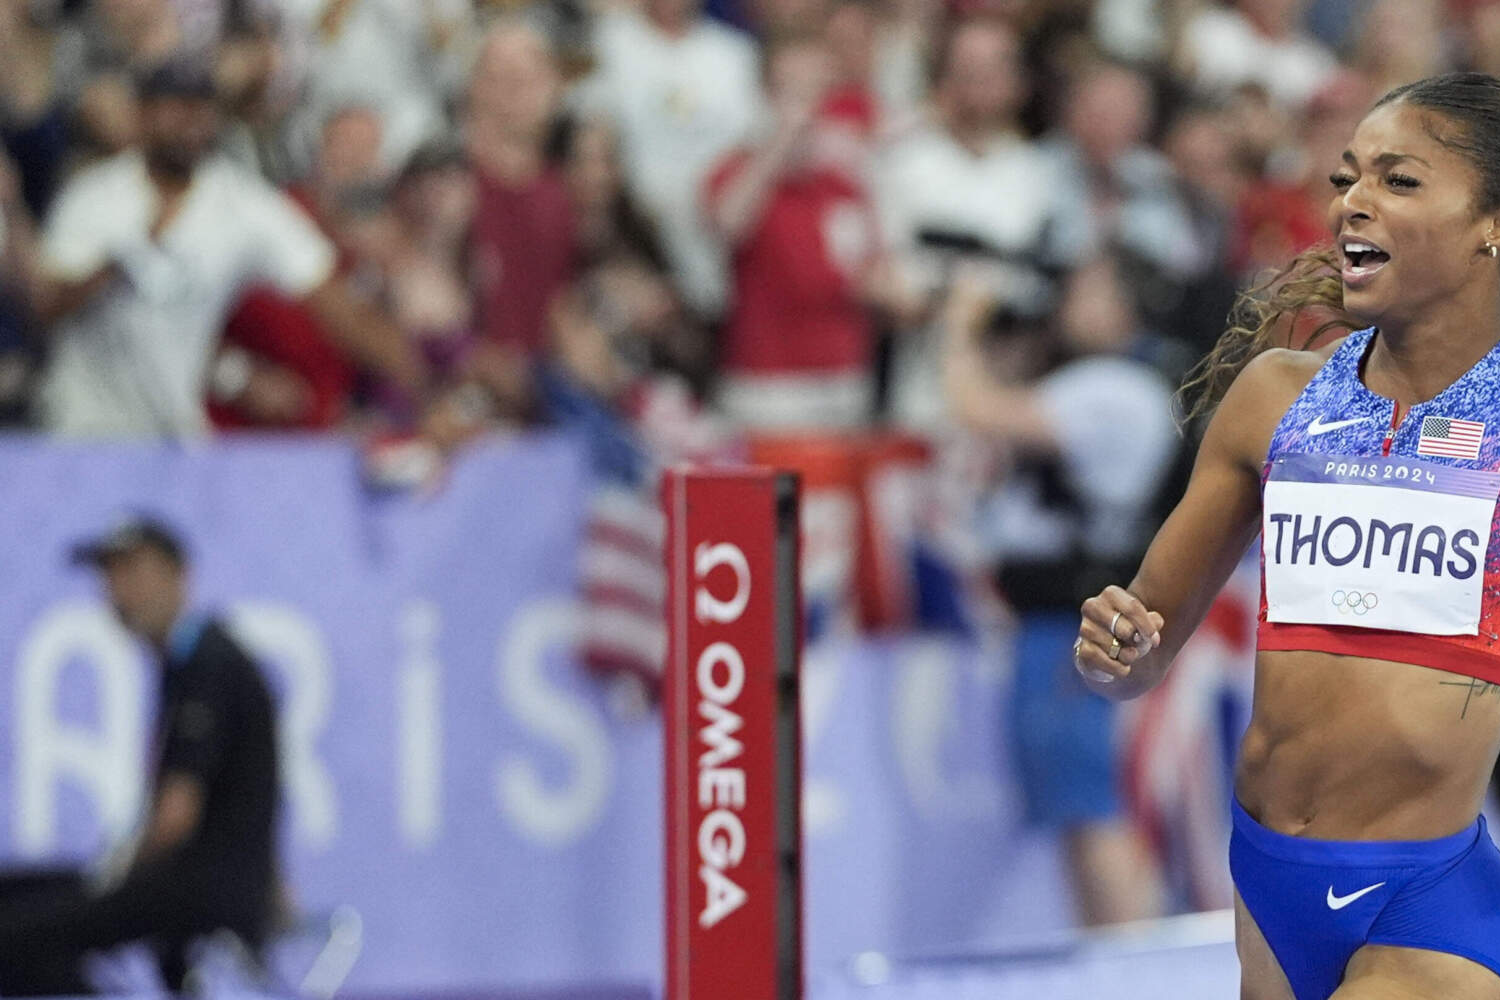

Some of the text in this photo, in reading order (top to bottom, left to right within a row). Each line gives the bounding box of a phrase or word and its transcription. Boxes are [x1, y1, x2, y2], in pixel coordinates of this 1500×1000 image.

[1324, 461, 1436, 485] PARIS 2024
[1270, 513, 1480, 580] THOMAS
[695, 641, 748, 930] OMEGA
